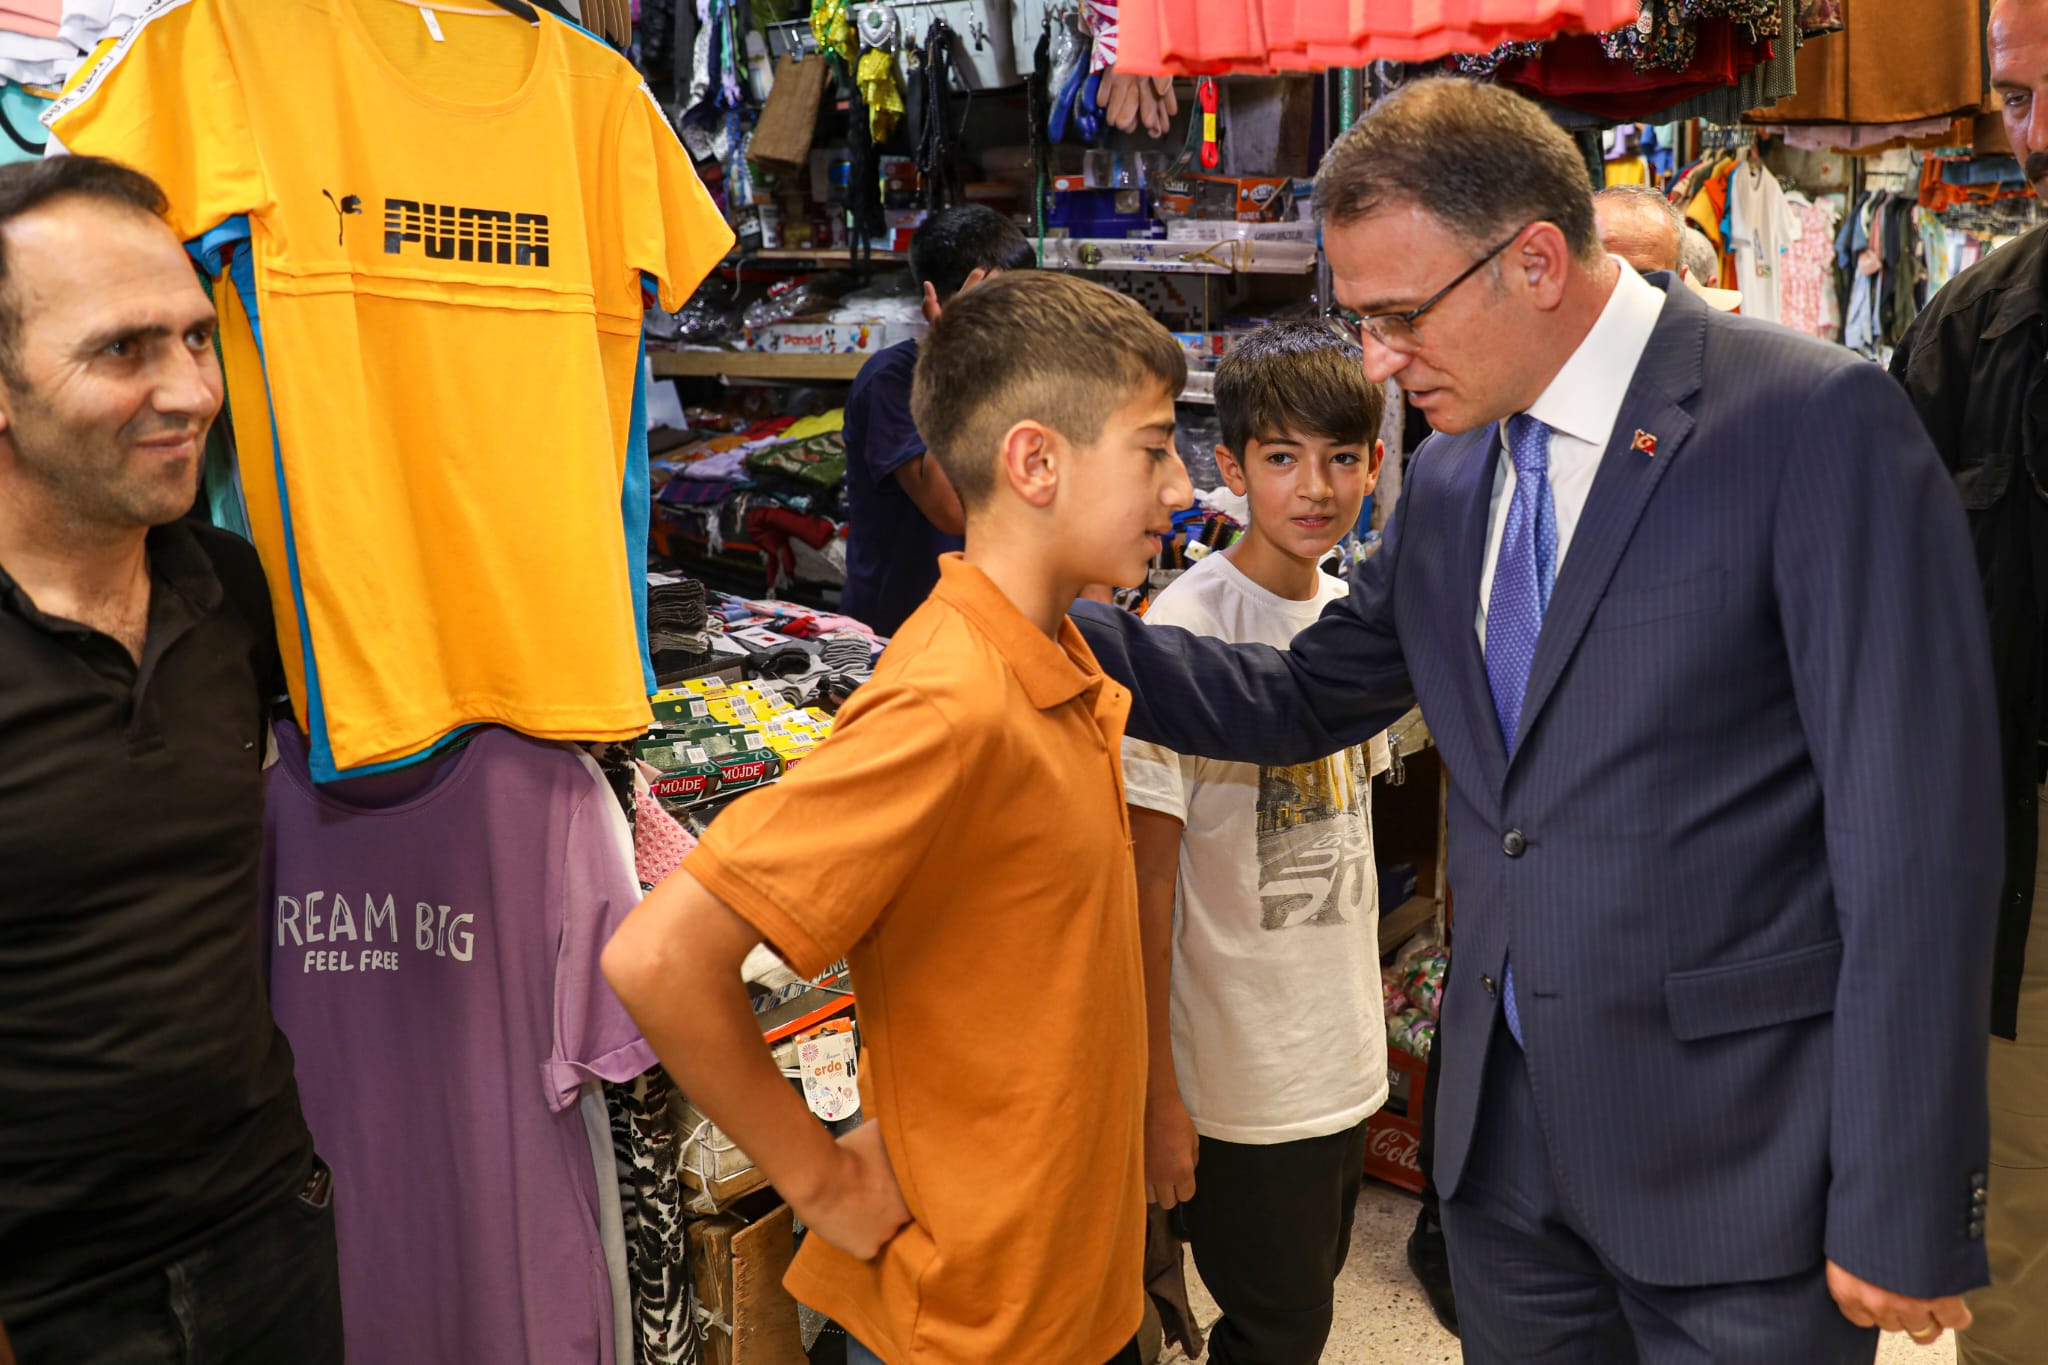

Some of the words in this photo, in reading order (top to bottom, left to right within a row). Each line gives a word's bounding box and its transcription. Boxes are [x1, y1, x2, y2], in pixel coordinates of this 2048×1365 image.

[384, 198, 549, 267] PUMA
[748, 749, 773, 760] 70
[690, 764, 716, 774] 70
[722, 764, 761, 780] MÜJDE
[660, 778, 702, 794] MÜJDE
[415, 901, 474, 962] BIG
[303, 950, 354, 973] FEEL
[359, 949, 399, 972] FREE
